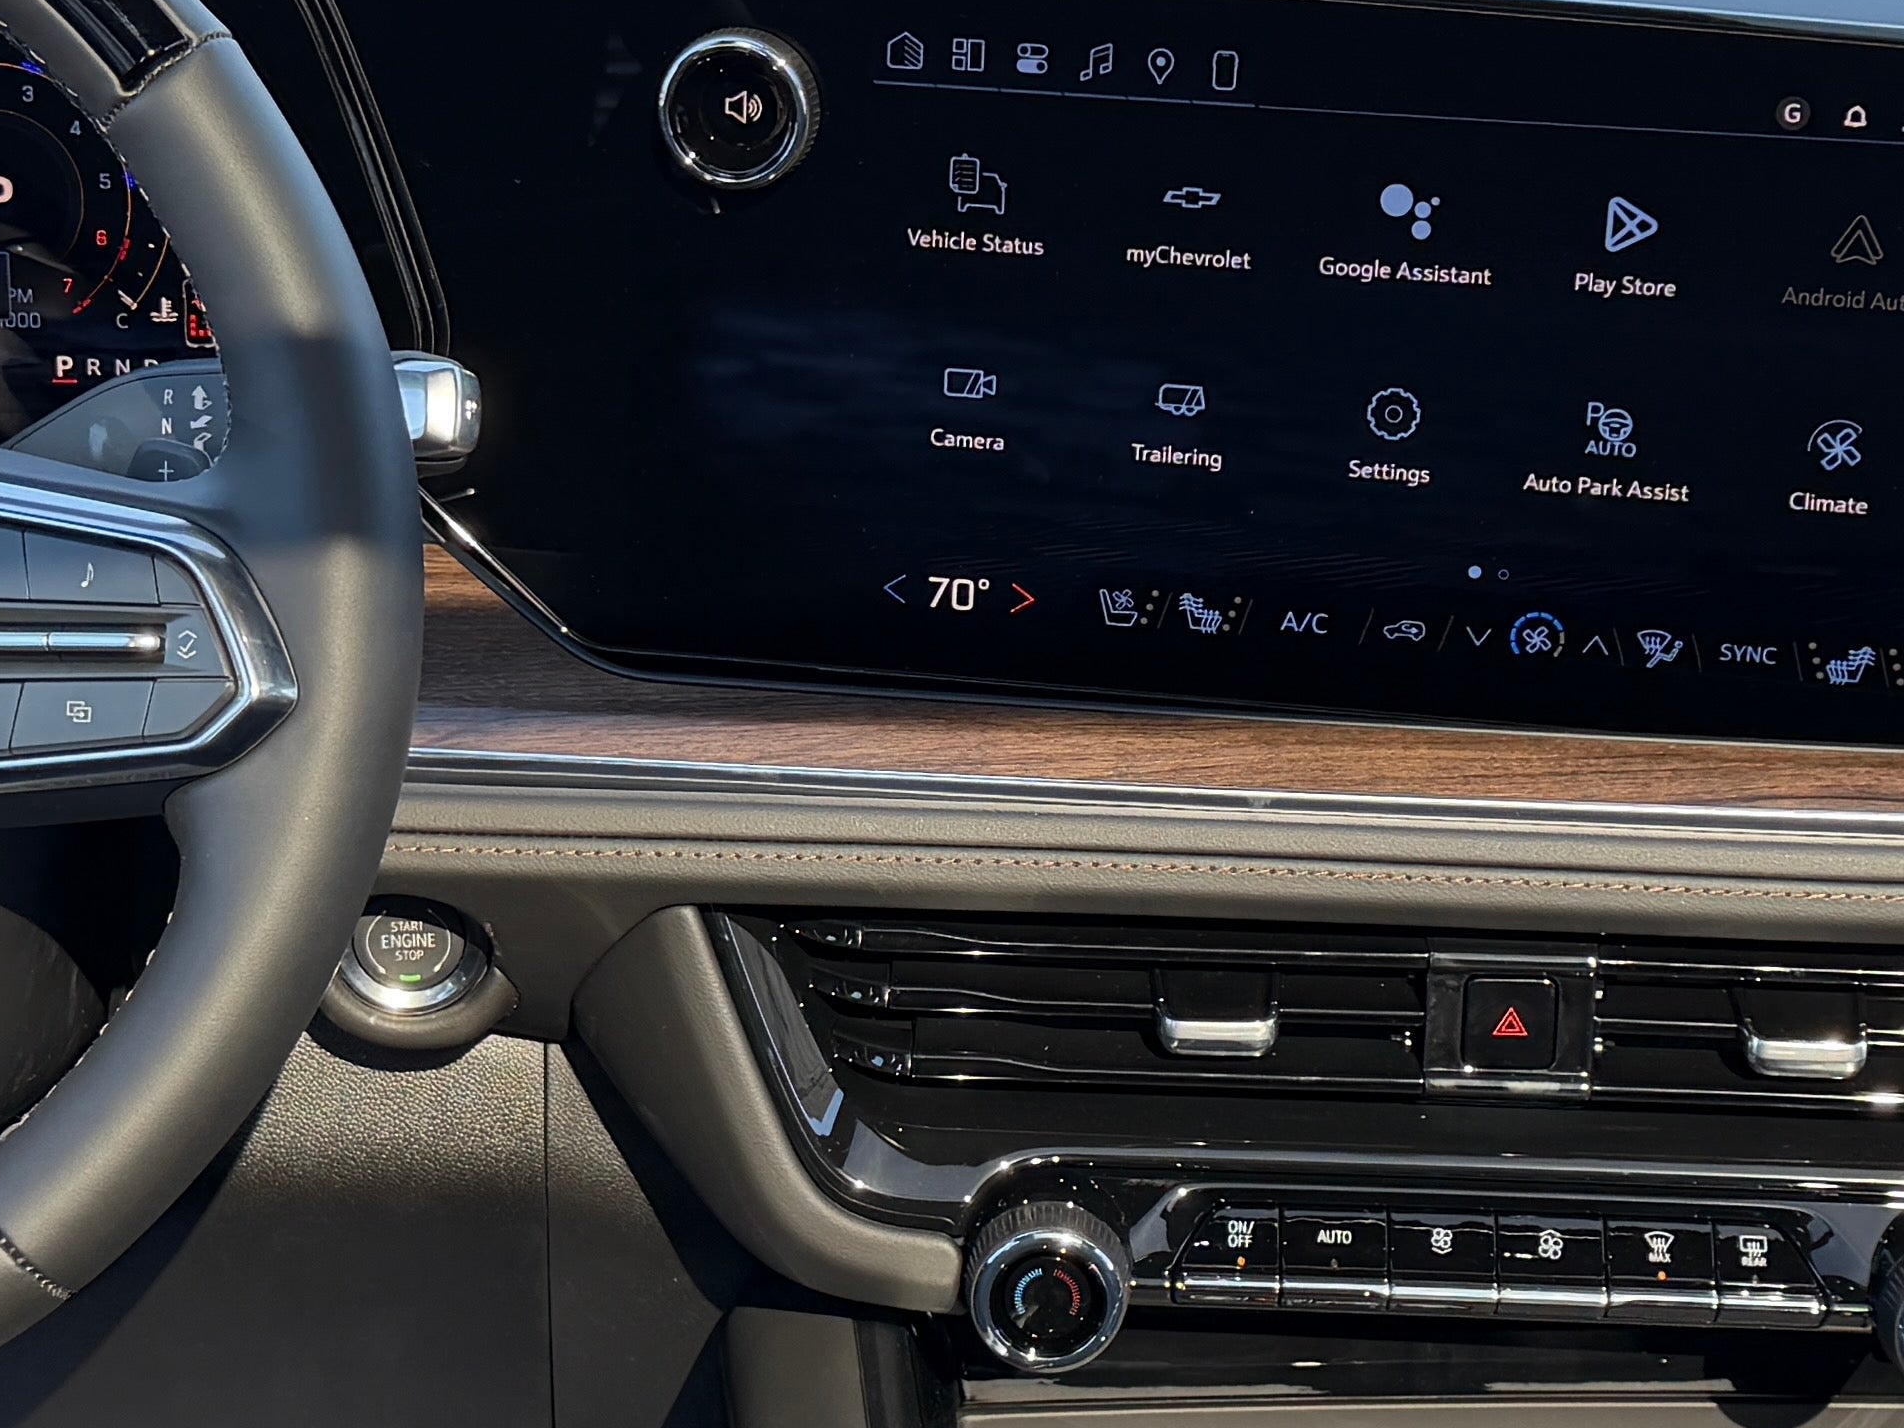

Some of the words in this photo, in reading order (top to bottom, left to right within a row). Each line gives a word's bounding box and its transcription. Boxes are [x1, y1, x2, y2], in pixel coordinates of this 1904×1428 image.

[22, 85, 34, 102] 3
[69, 120, 81, 137] 4
[99, 173, 111, 189] 5
[907, 228, 976, 253] Vehicle
[982, 232, 1045, 257] Status
[1126, 244, 1252, 271] myChevrolet
[1319, 256, 1391, 282] Google
[1396, 262, 1492, 286] Assistant
[1574, 272, 1616, 298] Play
[1620, 274, 1677, 298] Store
[1781, 286, 1866, 311] Android
[116, 313, 129, 329] C
[56, 355, 74, 377] P
[86, 358, 102, 376] R
[164, 389, 173, 405] R
[161, 418, 172, 435] N
[930, 429, 1005, 452] Camera
[1585, 439, 1637, 458] AUTO
[1131, 443, 1223, 471] Trailering
[1348, 460, 1431, 487] Settings
[1523, 472, 1574, 497] Auto
[1578, 476, 1623, 500] Park
[1627, 479, 1690, 504] Assist
[1789, 490, 1869, 516] Climate
[928, 576, 991, 612] 70°
[1280, 610, 1329, 636] A/C
[1719, 641, 1778, 666] SYNC
[390, 920, 424, 933] START
[381, 932, 437, 949] ENGINE
[395, 949, 425, 961] STOP
[1227, 1234, 1253, 1248] OFF
[1317, 1229, 1352, 1244] AUTO
